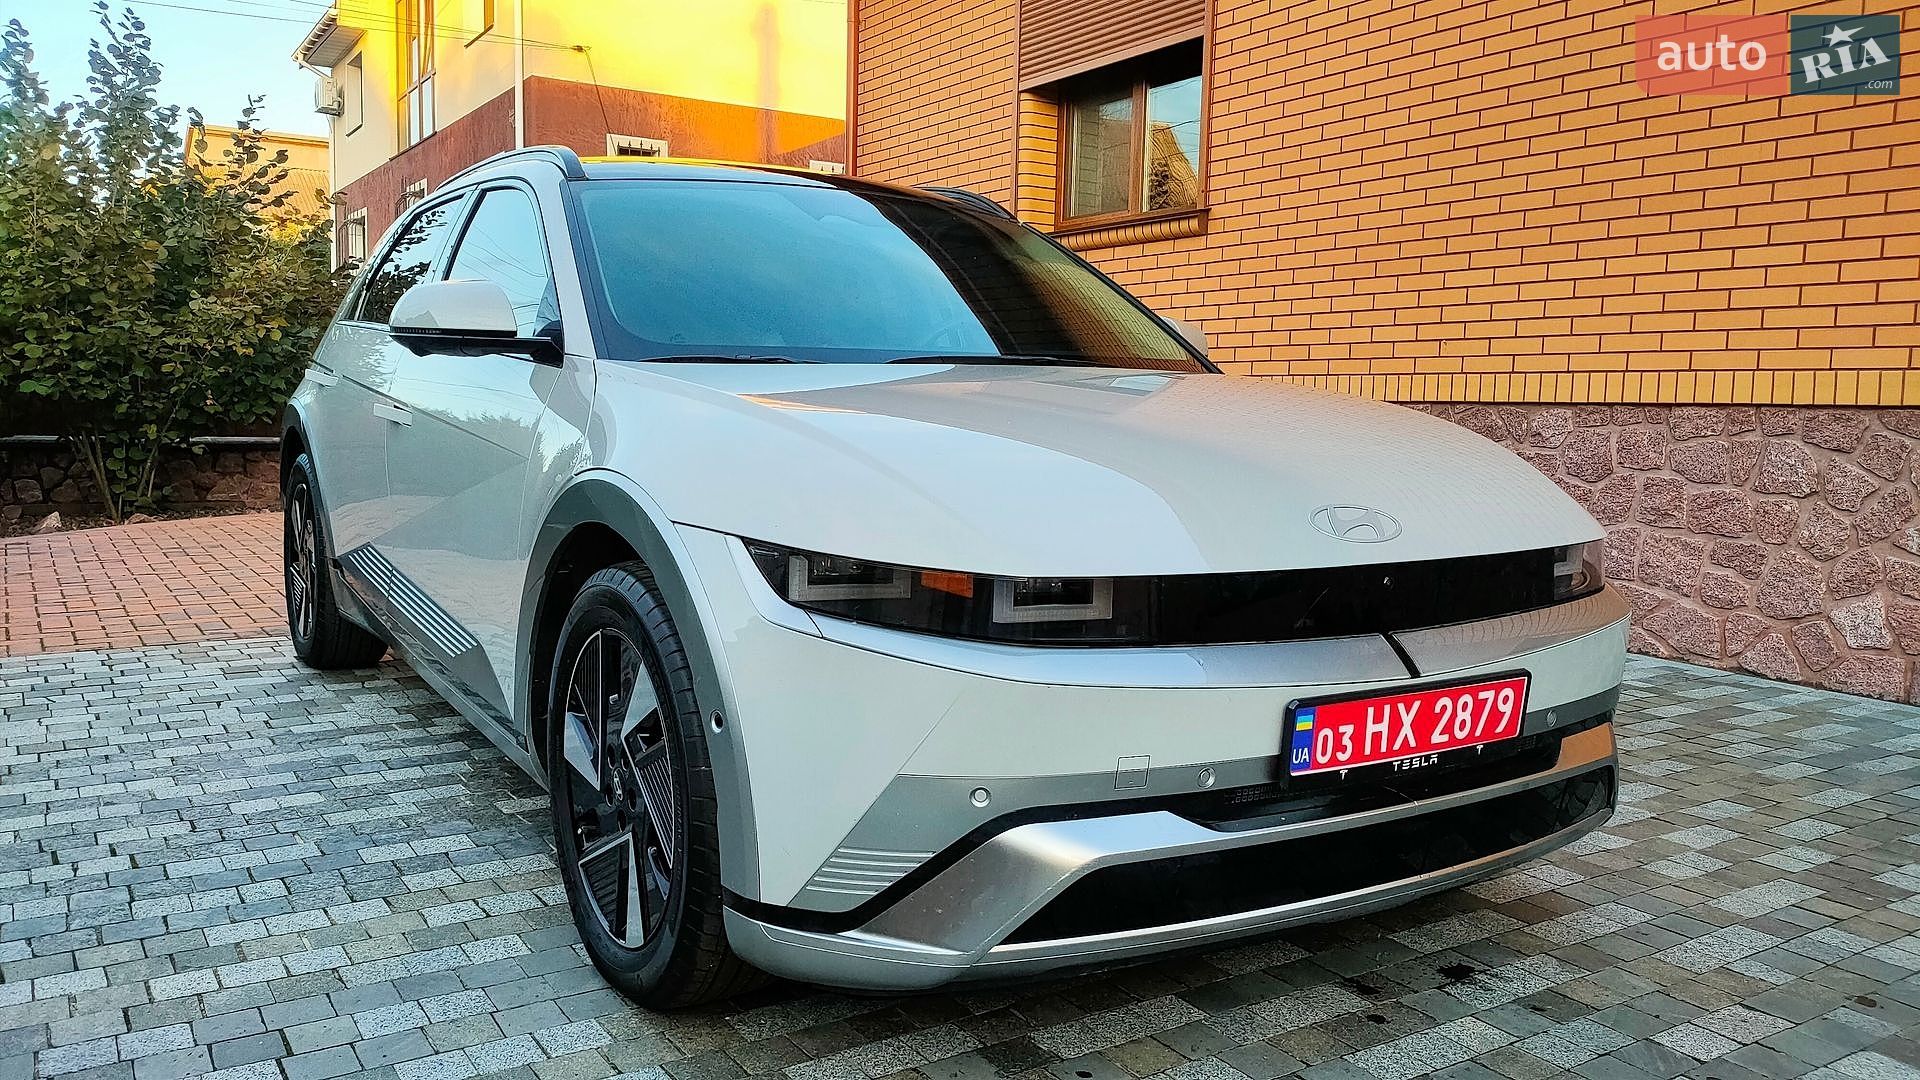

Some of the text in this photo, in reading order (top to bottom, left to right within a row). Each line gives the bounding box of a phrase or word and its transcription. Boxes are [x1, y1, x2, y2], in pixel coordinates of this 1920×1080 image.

[1292, 687, 1515, 764] UA 03 HX 2879
[1392, 754, 1438, 772] TESLA
